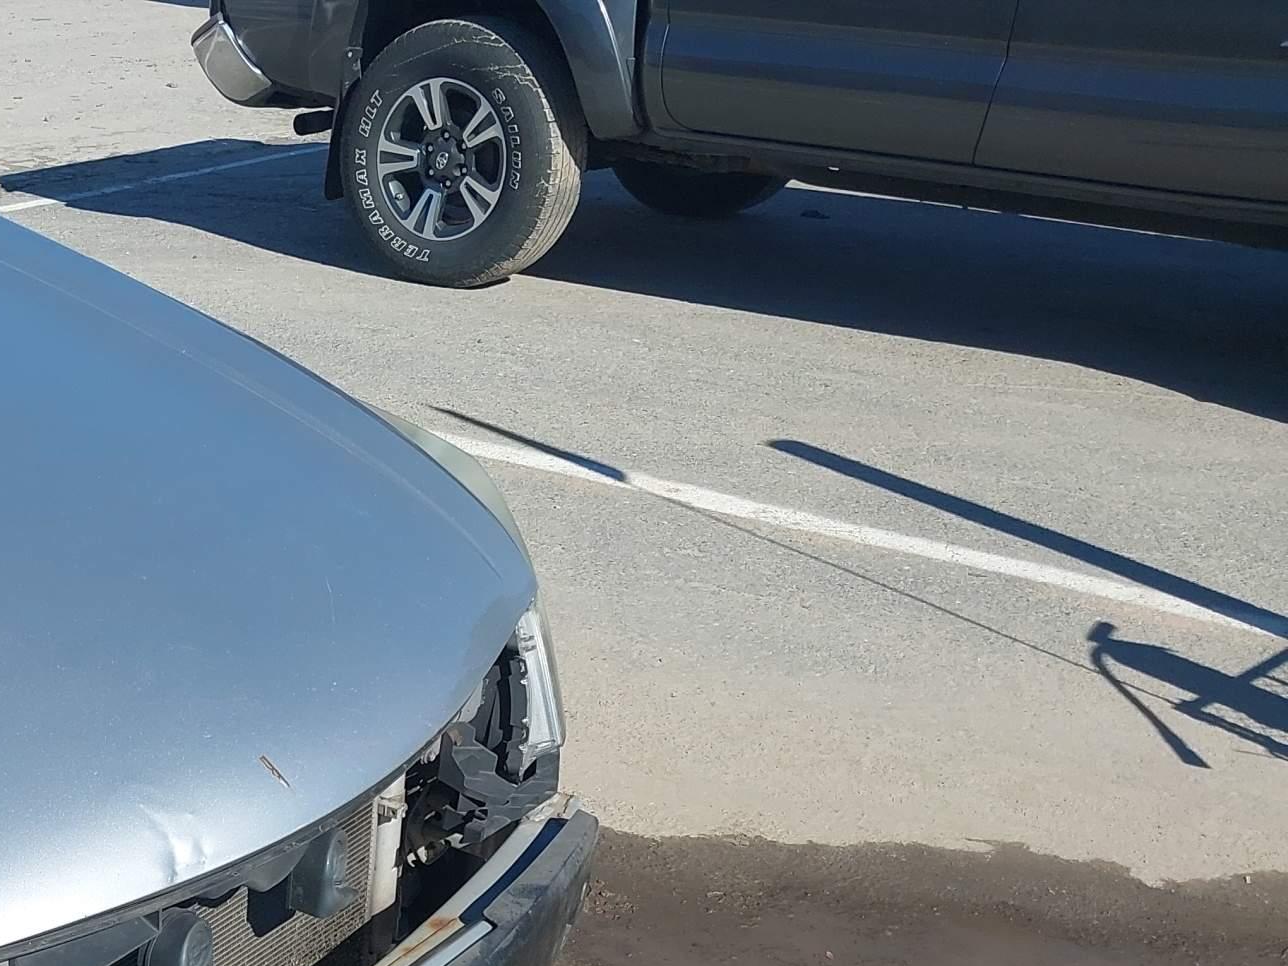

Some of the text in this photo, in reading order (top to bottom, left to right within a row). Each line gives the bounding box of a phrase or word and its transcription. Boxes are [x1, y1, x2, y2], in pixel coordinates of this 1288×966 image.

[354, 88, 432, 262] TERRAMAX HLT
[491, 87, 523, 190] SAILUN
